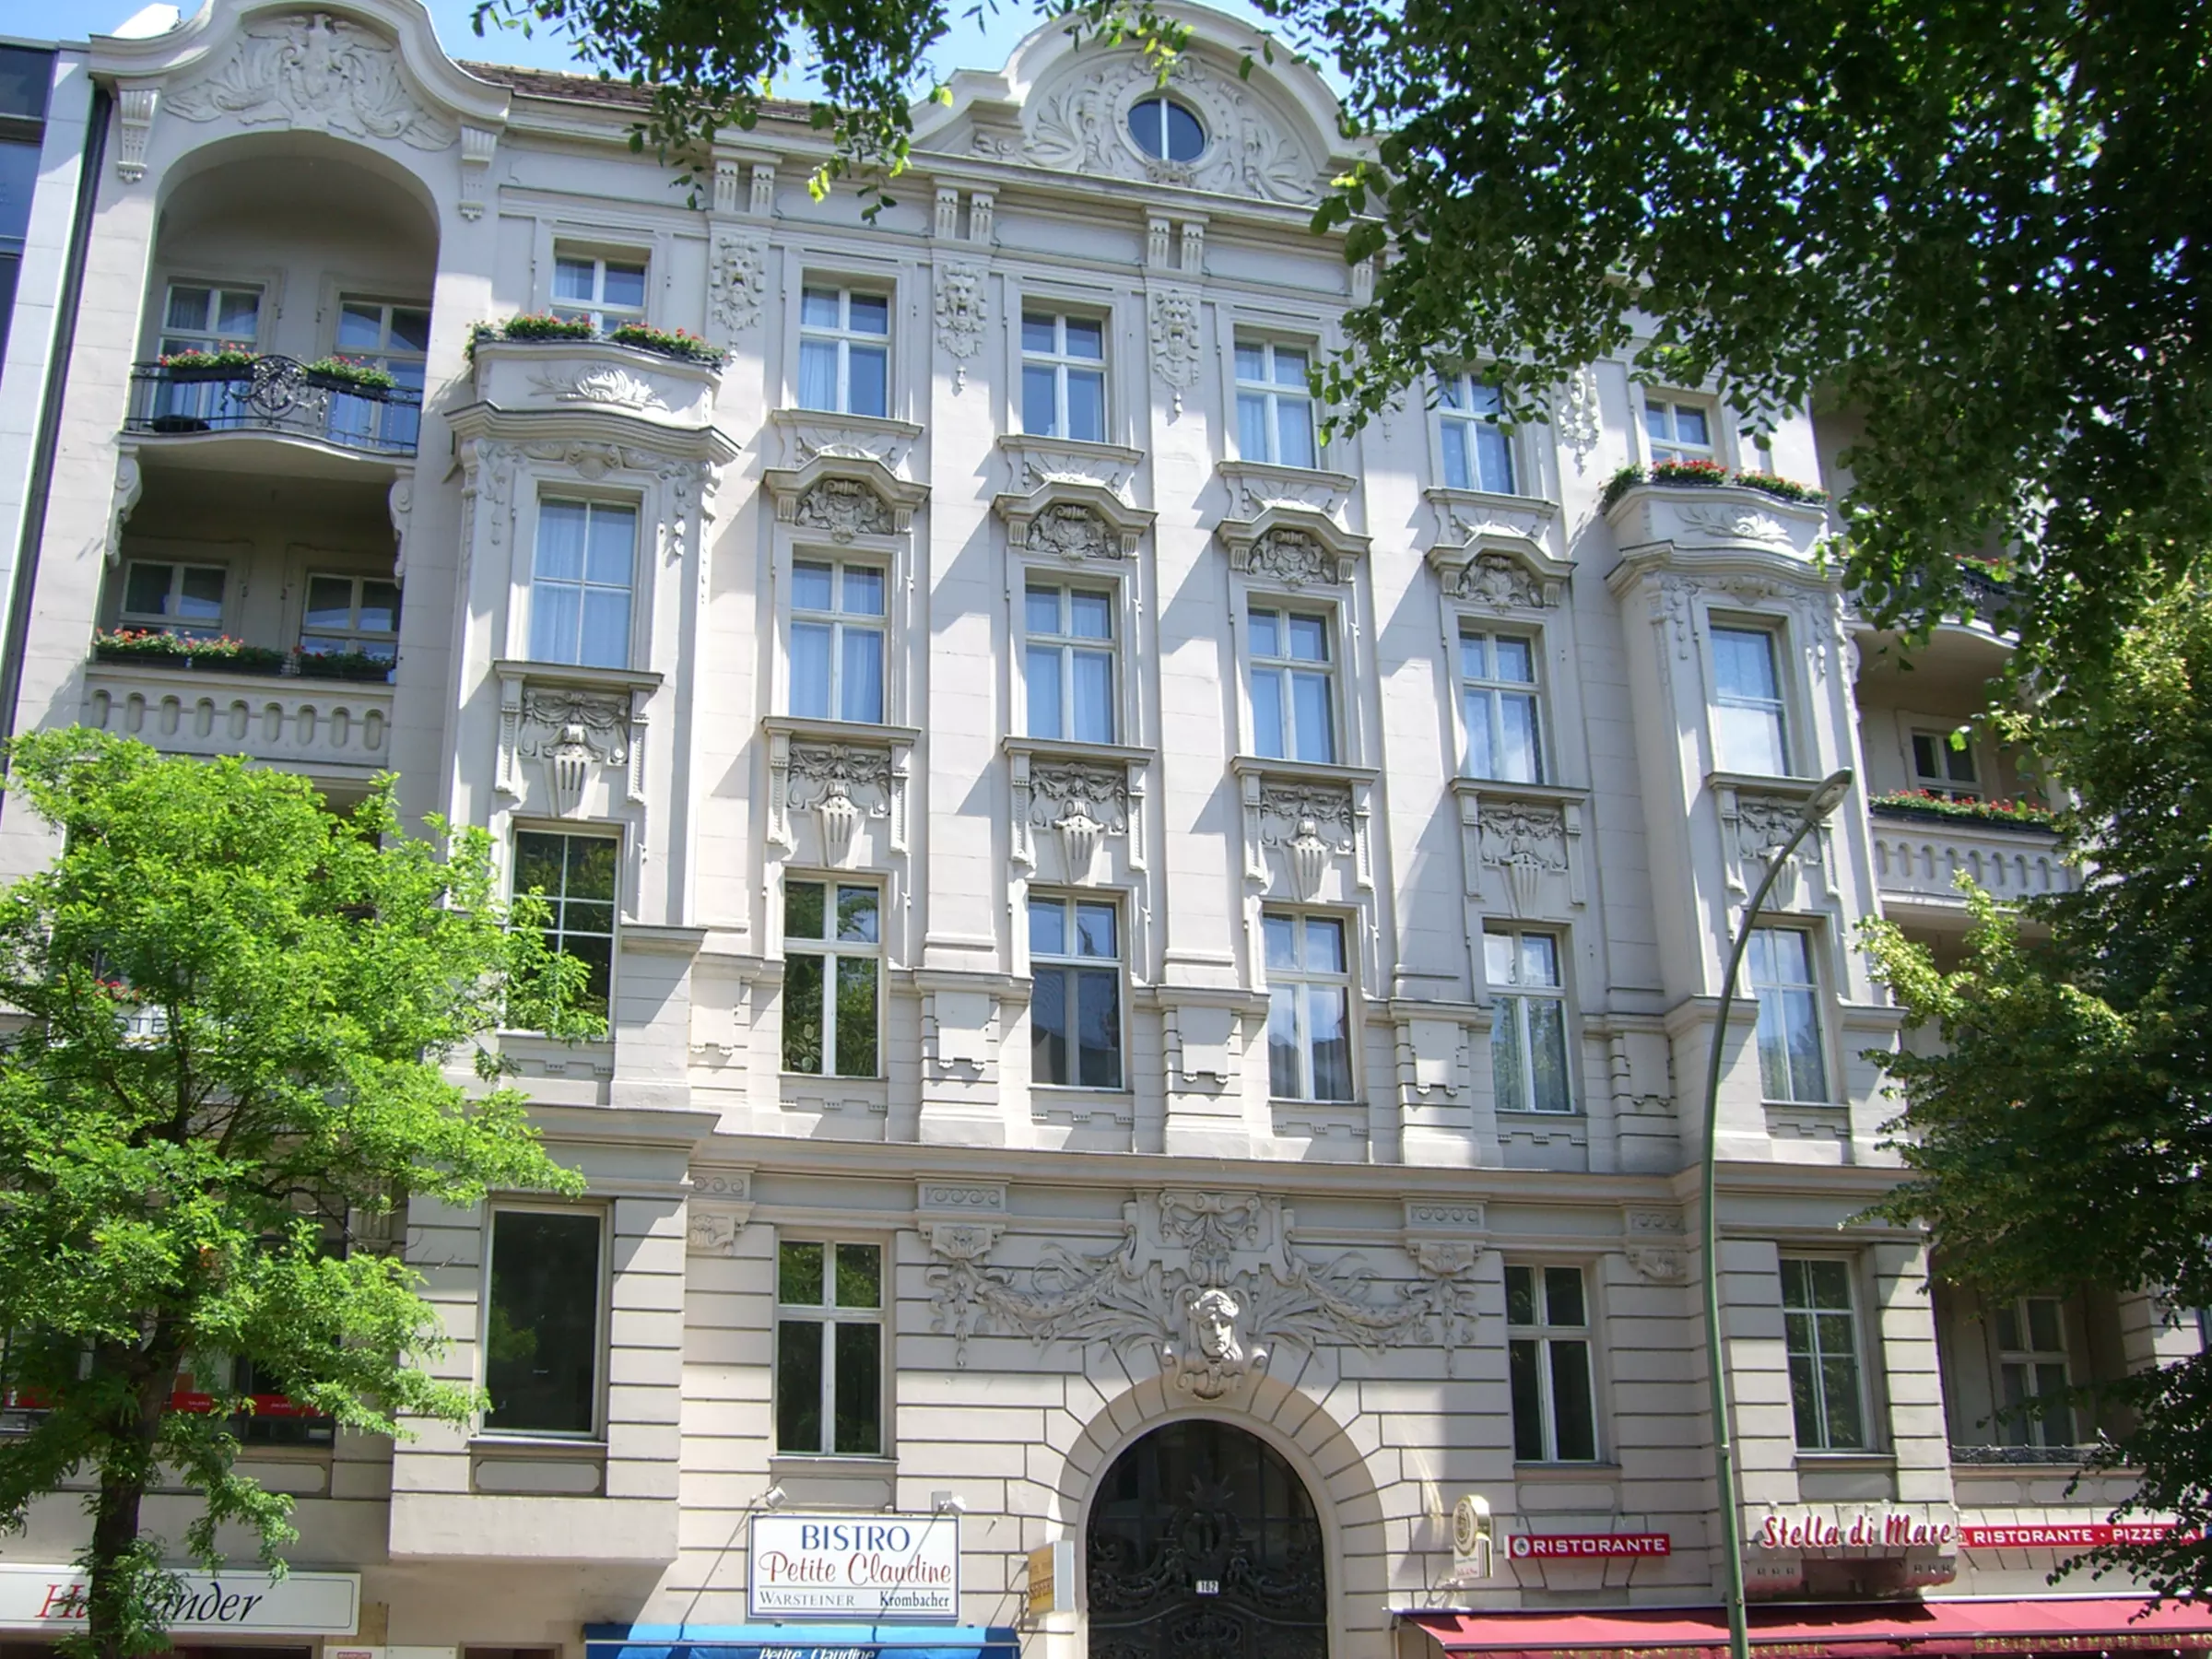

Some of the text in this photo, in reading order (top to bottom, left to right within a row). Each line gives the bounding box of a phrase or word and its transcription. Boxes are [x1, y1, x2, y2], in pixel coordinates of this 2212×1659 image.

[801, 1524, 911, 1552] BISTRO
[1762, 1513, 1951, 1547] Stella di Mare
[1972, 1527, 2196, 1545] RISTORANTE PIZZEA
[1533, 1537, 1666, 1553] RISTORANTE
[758, 1551, 952, 1586] Petite Claudine
[759, 1590, 950, 1608] WARSTEINER Krombacher
